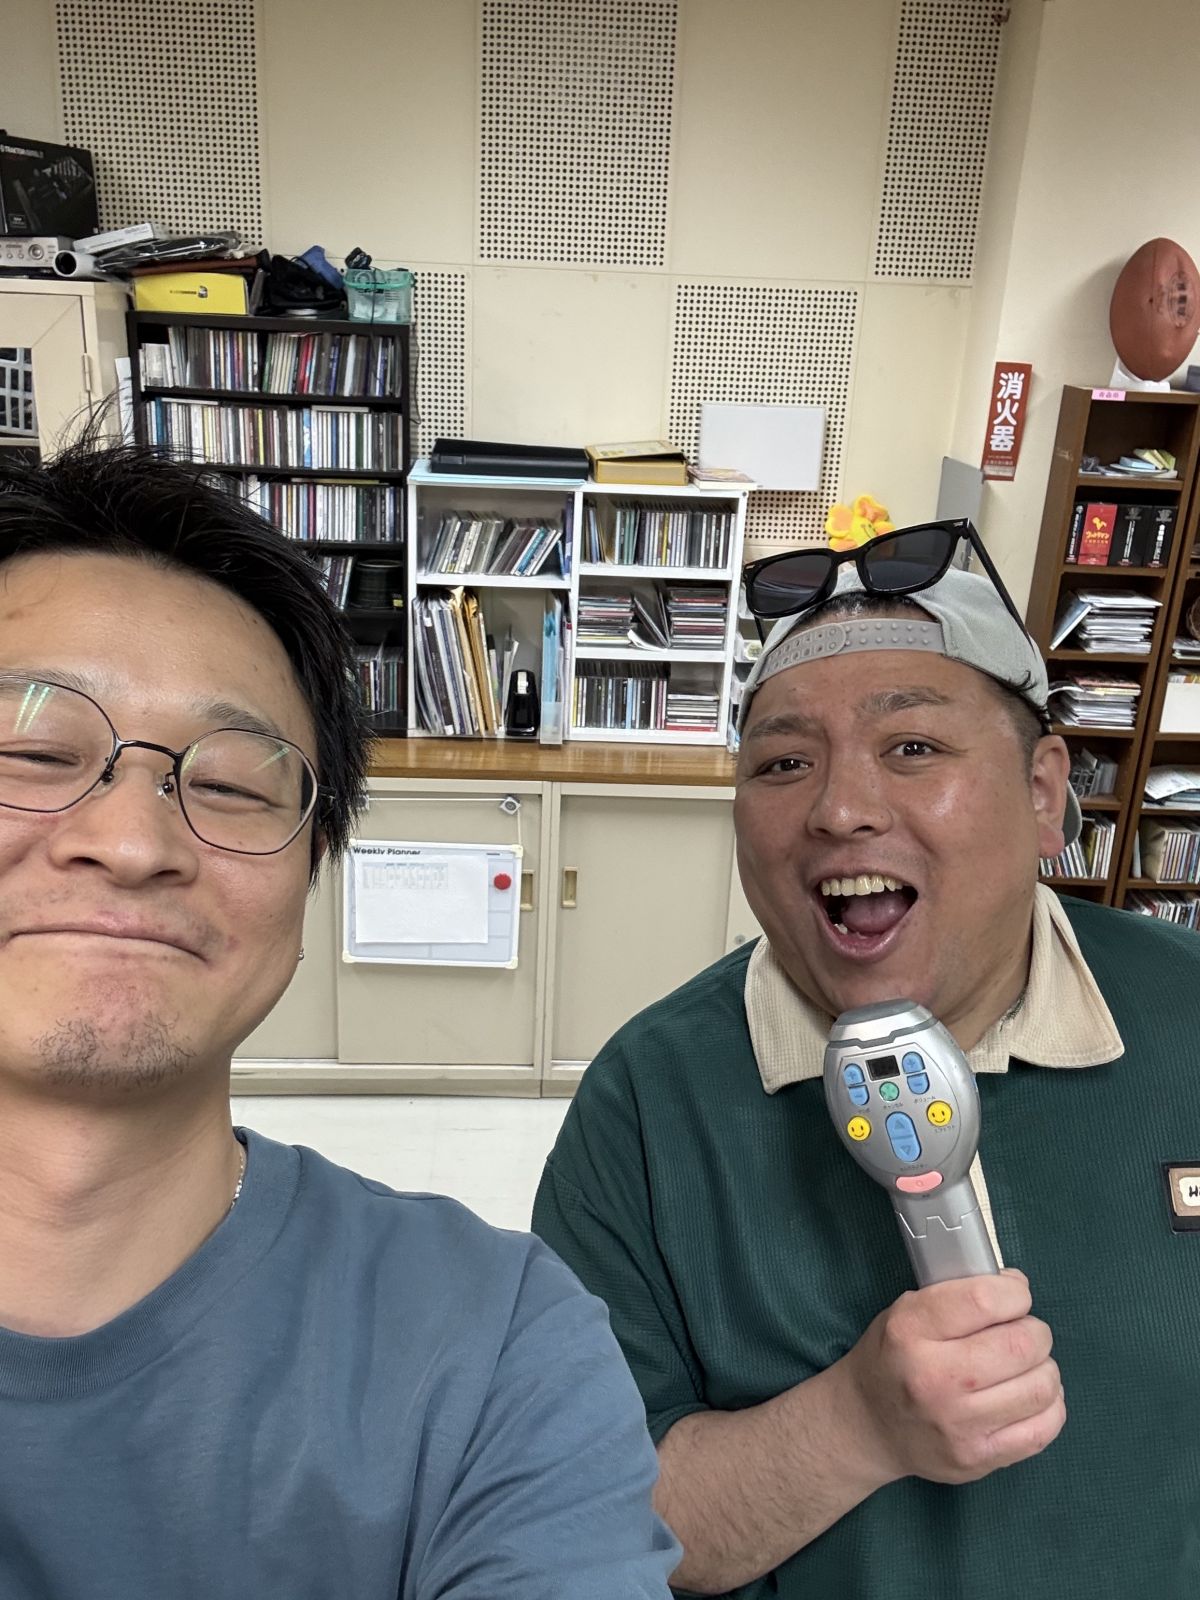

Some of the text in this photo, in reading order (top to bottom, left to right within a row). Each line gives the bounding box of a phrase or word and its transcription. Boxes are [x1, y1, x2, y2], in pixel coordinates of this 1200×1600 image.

[990, 371, 1025, 452] 消火器
[353, 847, 385, 855] Weekly
